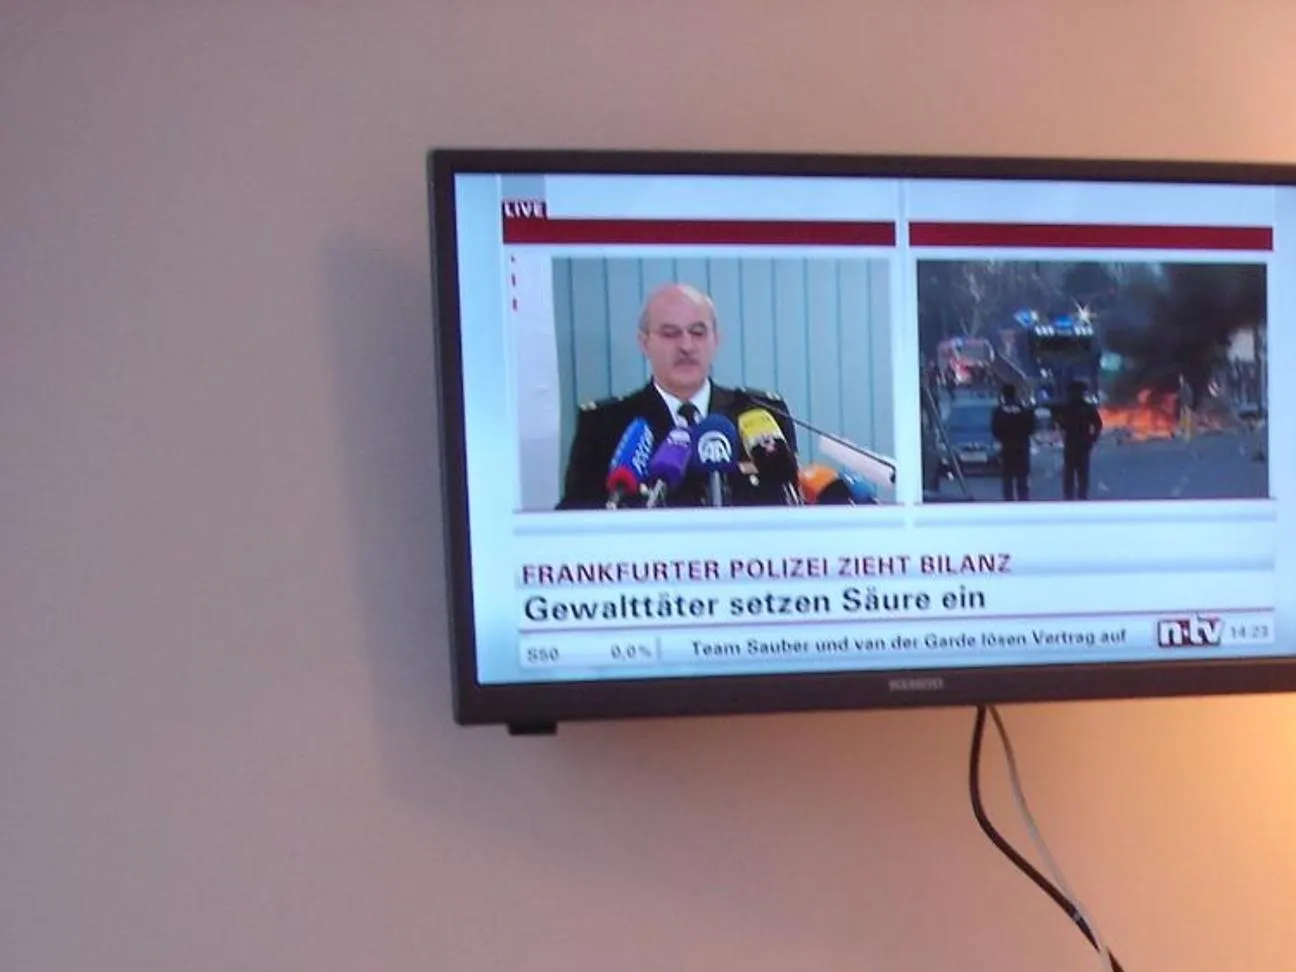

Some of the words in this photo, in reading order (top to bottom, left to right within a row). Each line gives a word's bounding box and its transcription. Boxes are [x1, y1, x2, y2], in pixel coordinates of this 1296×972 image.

[504, 199, 544, 218] LIVE
[523, 560, 720, 585] FRANKFURTER
[730, 556, 829, 580] POLIZEI
[838, 553, 910, 577] ZIEHT
[920, 552, 1013, 575] BILANZ
[524, 593, 718, 621] Gewalttäter
[729, 589, 831, 617] setzen
[841, 584, 931, 614] Säure
[941, 584, 986, 610] ein
[692, 639, 741, 656] Team
[747, 636, 809, 655] Sauber
[814, 634, 849, 651] und
[854, 635, 886, 650] van
[891, 632, 918, 649] der
[925, 630, 976, 648] Garde
[980, 630, 1027, 648] lösen
[1032, 628, 1095, 648] Vertrag
[1100, 628, 1127, 644] auf
